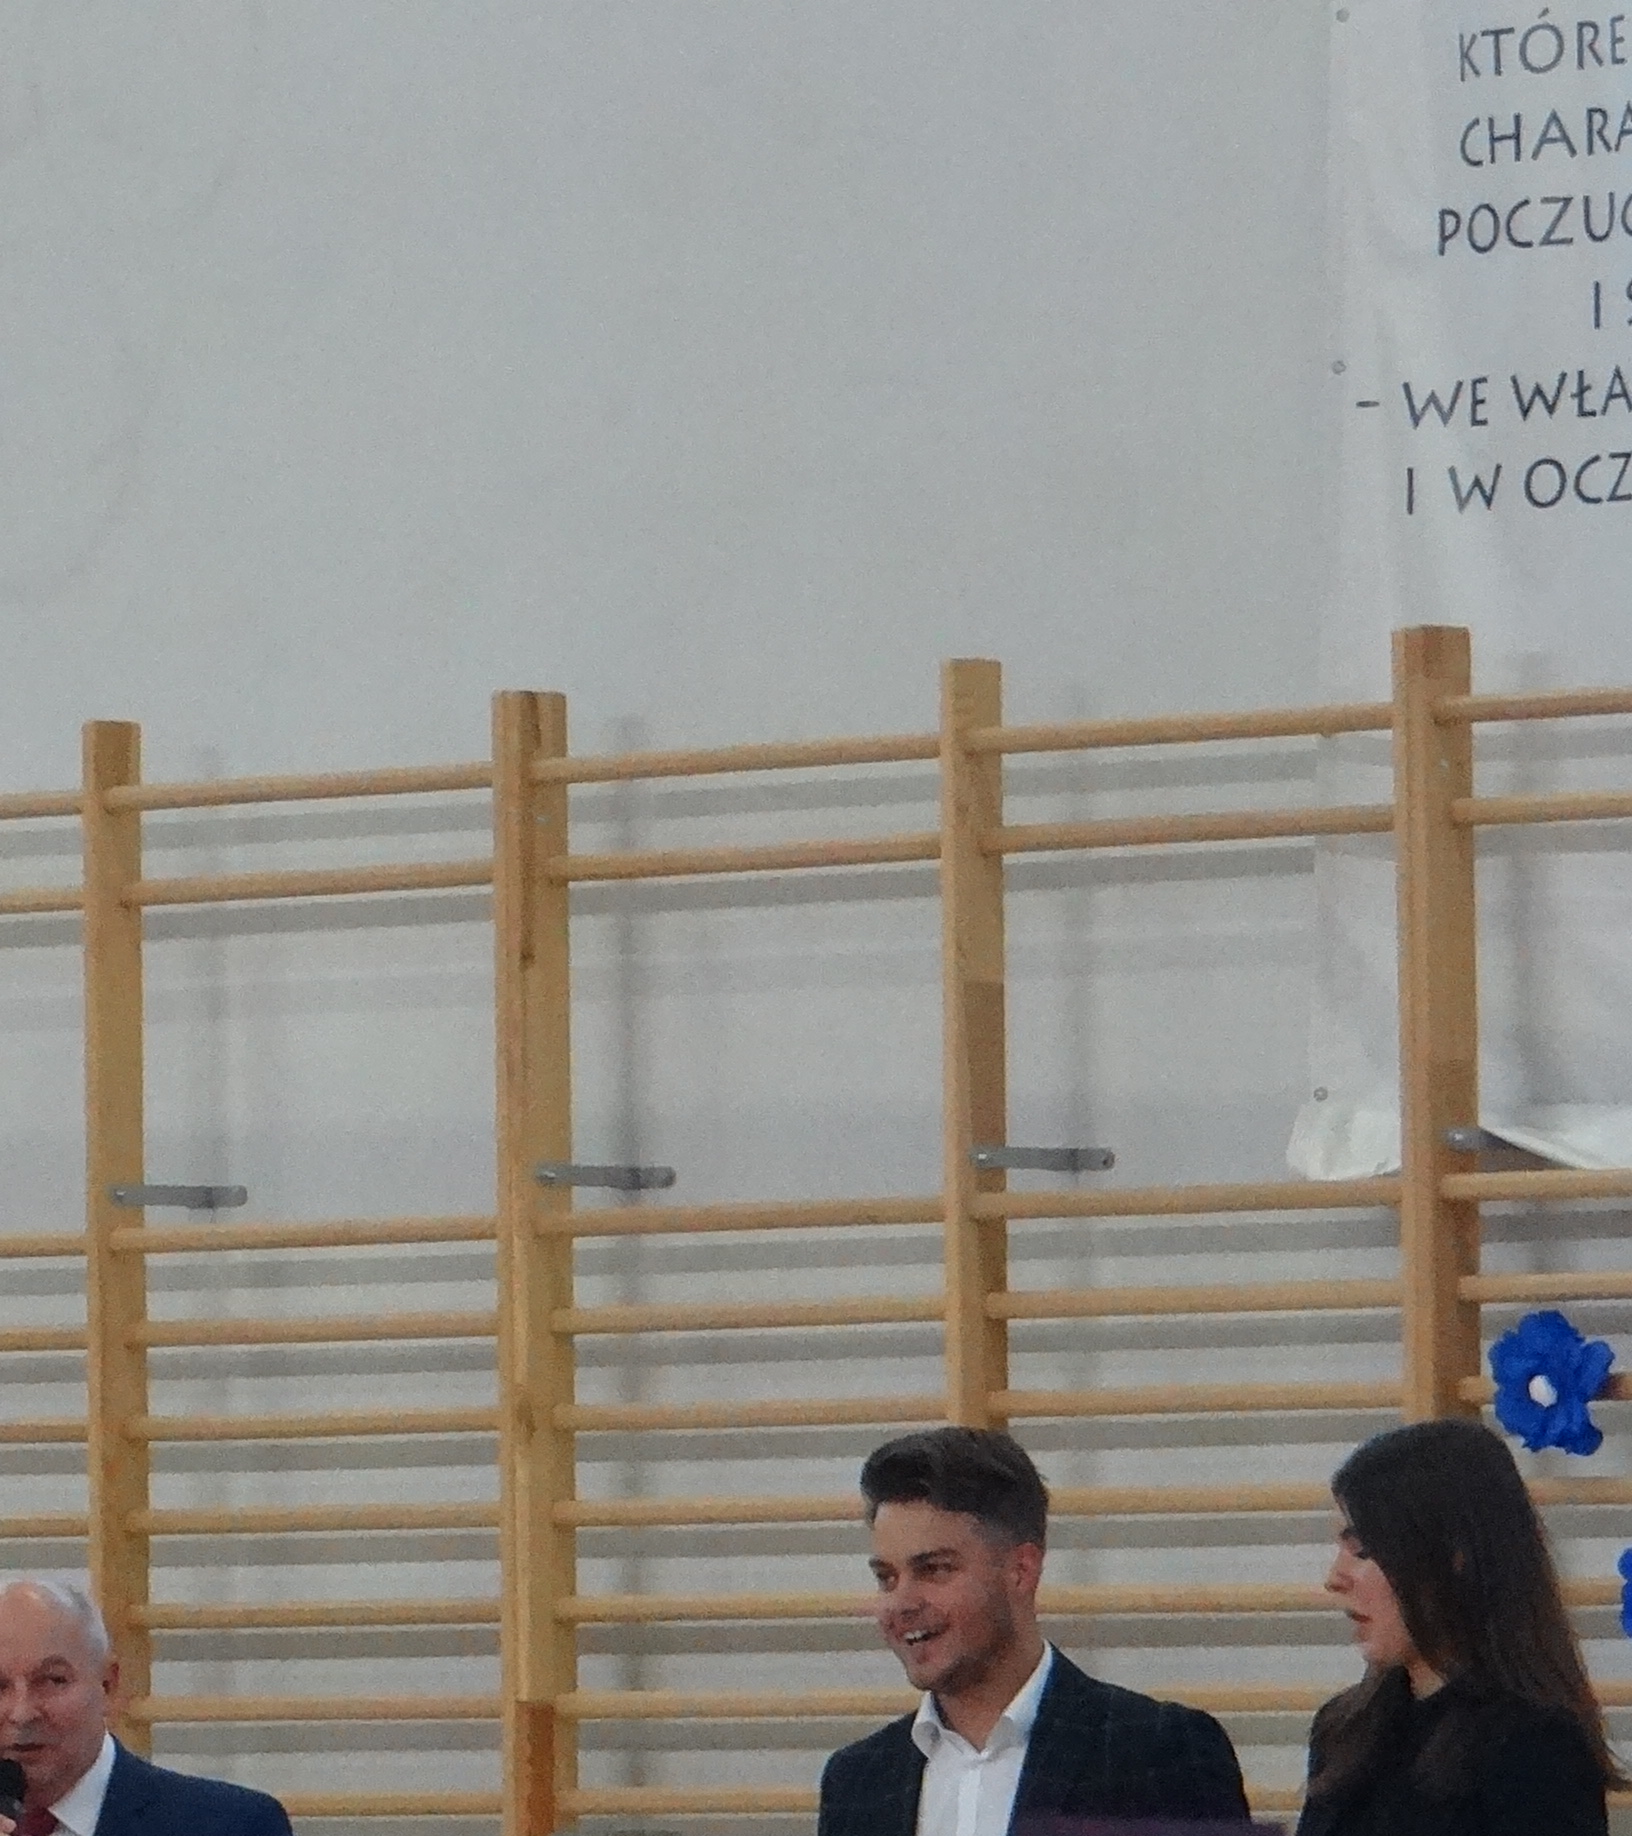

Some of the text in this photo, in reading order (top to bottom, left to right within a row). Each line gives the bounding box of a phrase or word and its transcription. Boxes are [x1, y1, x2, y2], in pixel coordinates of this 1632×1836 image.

[1459, 8, 1626, 82] KTÓRE
[1592, 281, 1602, 330] I
[1402, 376, 1489, 429] WE
[1404, 467, 1416, 515] I
[1448, 463, 1502, 511] W
